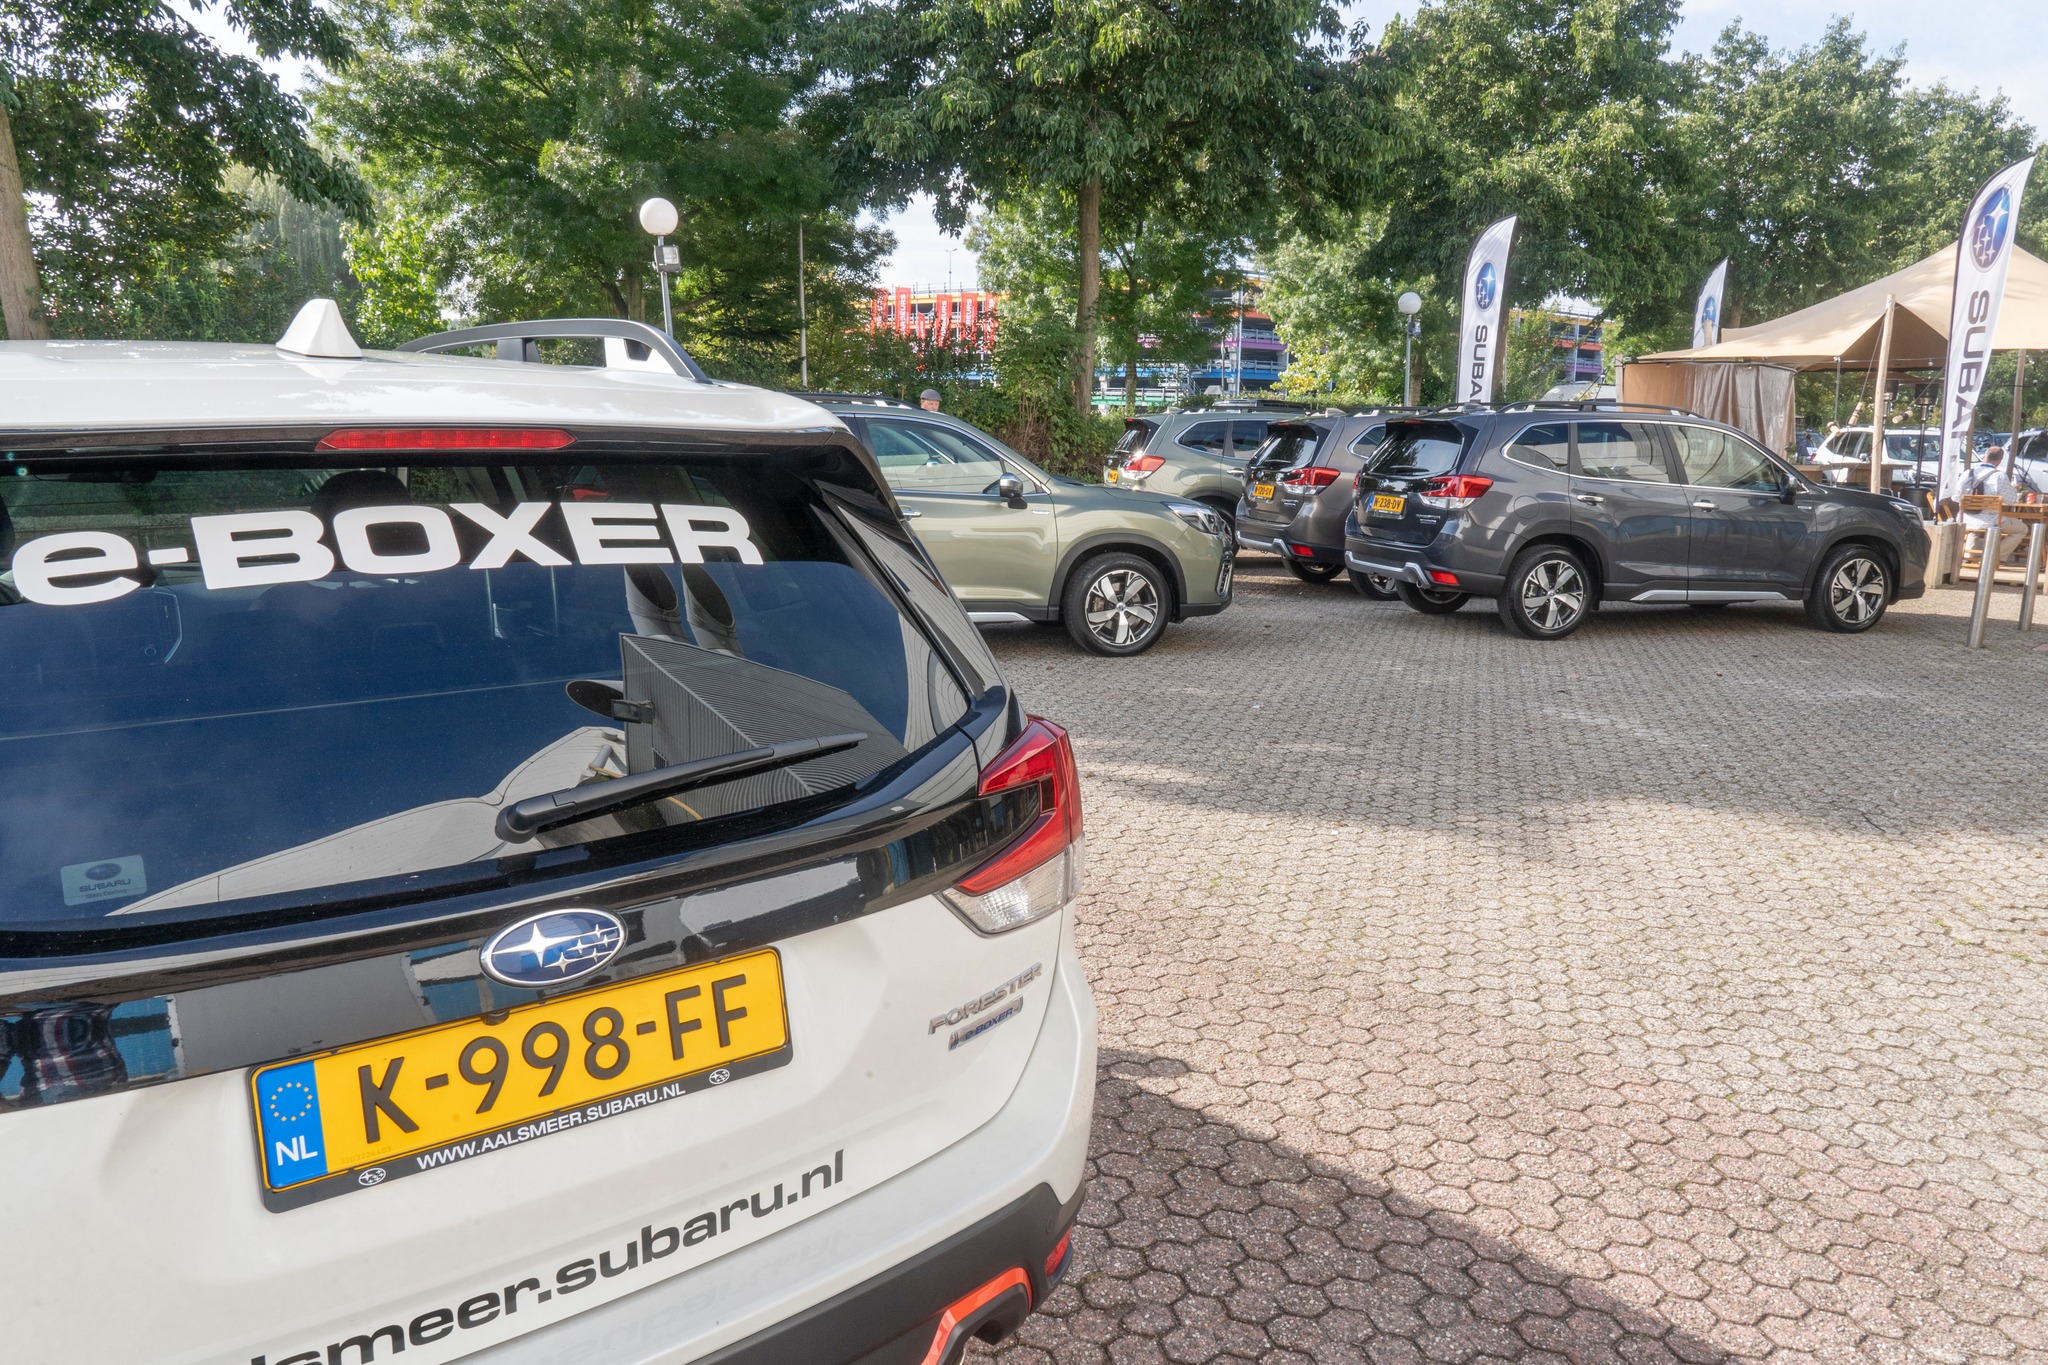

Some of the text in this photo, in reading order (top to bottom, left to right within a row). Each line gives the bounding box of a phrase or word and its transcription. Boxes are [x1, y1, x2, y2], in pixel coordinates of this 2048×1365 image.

[12, 501, 764, 606] e-BOXER
[79, 878, 131, 893] SUBARU
[927, 961, 1043, 1035] FORESTER
[965, 1007, 1014, 1040] e-BOXER
[357, 973, 749, 1145] K-998-FF
[275, 1135, 318, 1167] NL
[416, 1083, 686, 1170] WWW.AALSMEER.SUBARU.NL
[251, 1150, 845, 1365] smeer.subaru.nl
